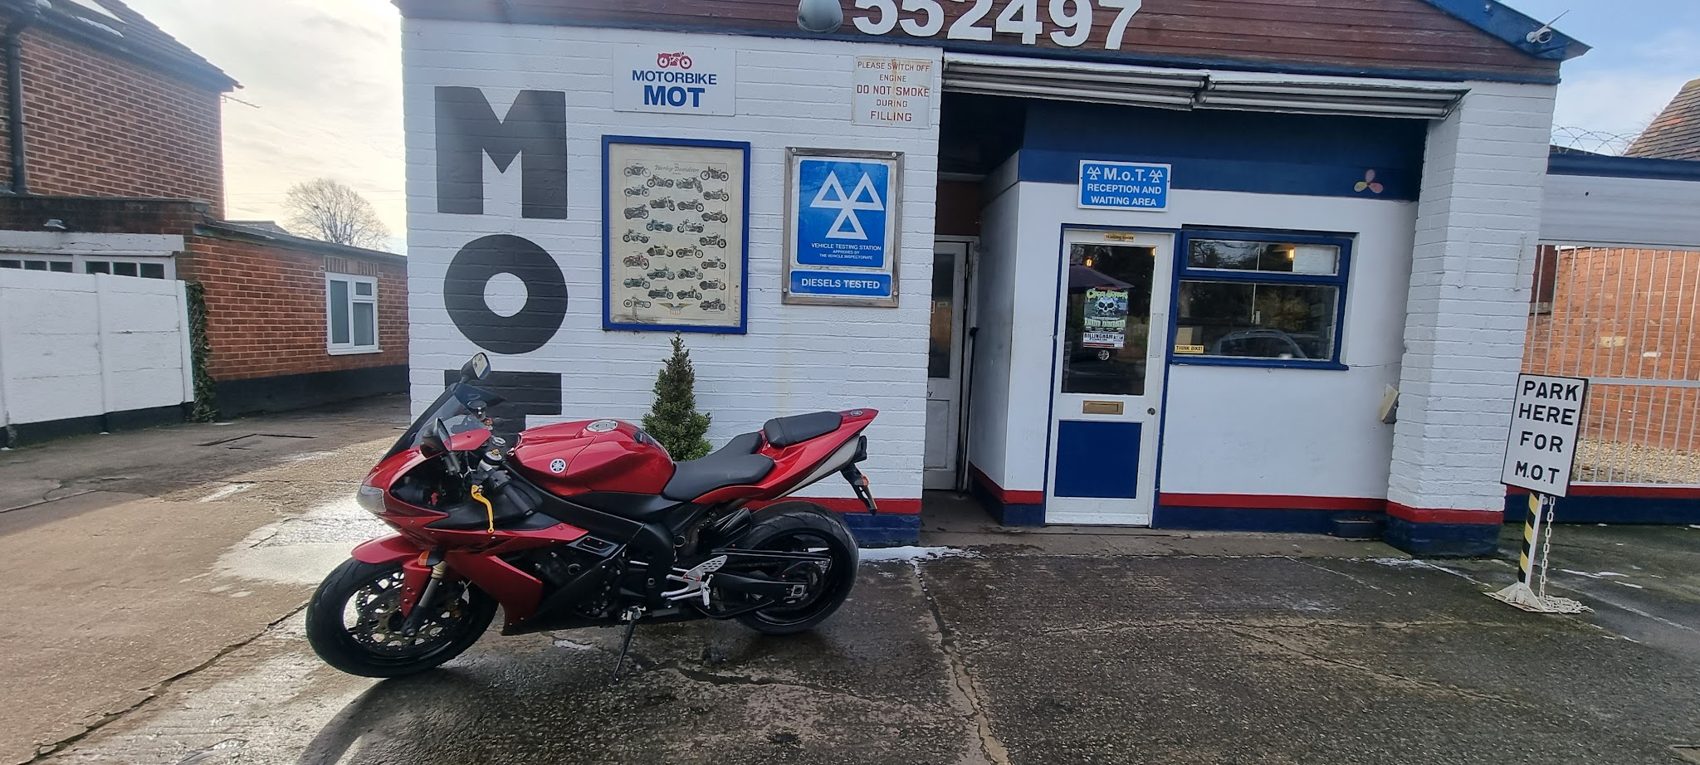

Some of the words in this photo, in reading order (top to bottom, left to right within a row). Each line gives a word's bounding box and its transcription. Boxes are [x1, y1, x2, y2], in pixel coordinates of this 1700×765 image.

[852, 0, 1142, 50] 552497
[857, 61, 885, 69] PLEASE
[887, 63, 914, 71] SWITCH
[916, 64, 930, 73] OFF
[632, 70, 717, 85] MOTORBIKE
[879, 73, 907, 83] ENGINE
[643, 84, 705, 108] MOT
[856, 84, 870, 94] DO
[873, 85, 892, 96] NOT
[895, 86, 930, 98] SMOKE
[876, 98, 908, 108] DURING
[870, 110, 912, 122] FILLING
[1103, 167, 1147, 182] M.o.T.
[1087, 183, 1139, 193] RECEPTION
[1141, 186, 1162, 195] AND
[1090, 195, 1130, 205] WAITING
[1131, 197, 1157, 207] AREA
[801, 279, 841, 288] DIESELS
[843, 280, 880, 289] TESTED
[1522, 380, 1580, 401] PARK
[1518, 402, 1576, 426] HERE
[1520, 430, 1563, 453] FOR
[1515, 460, 1560, 484] M.O.T
